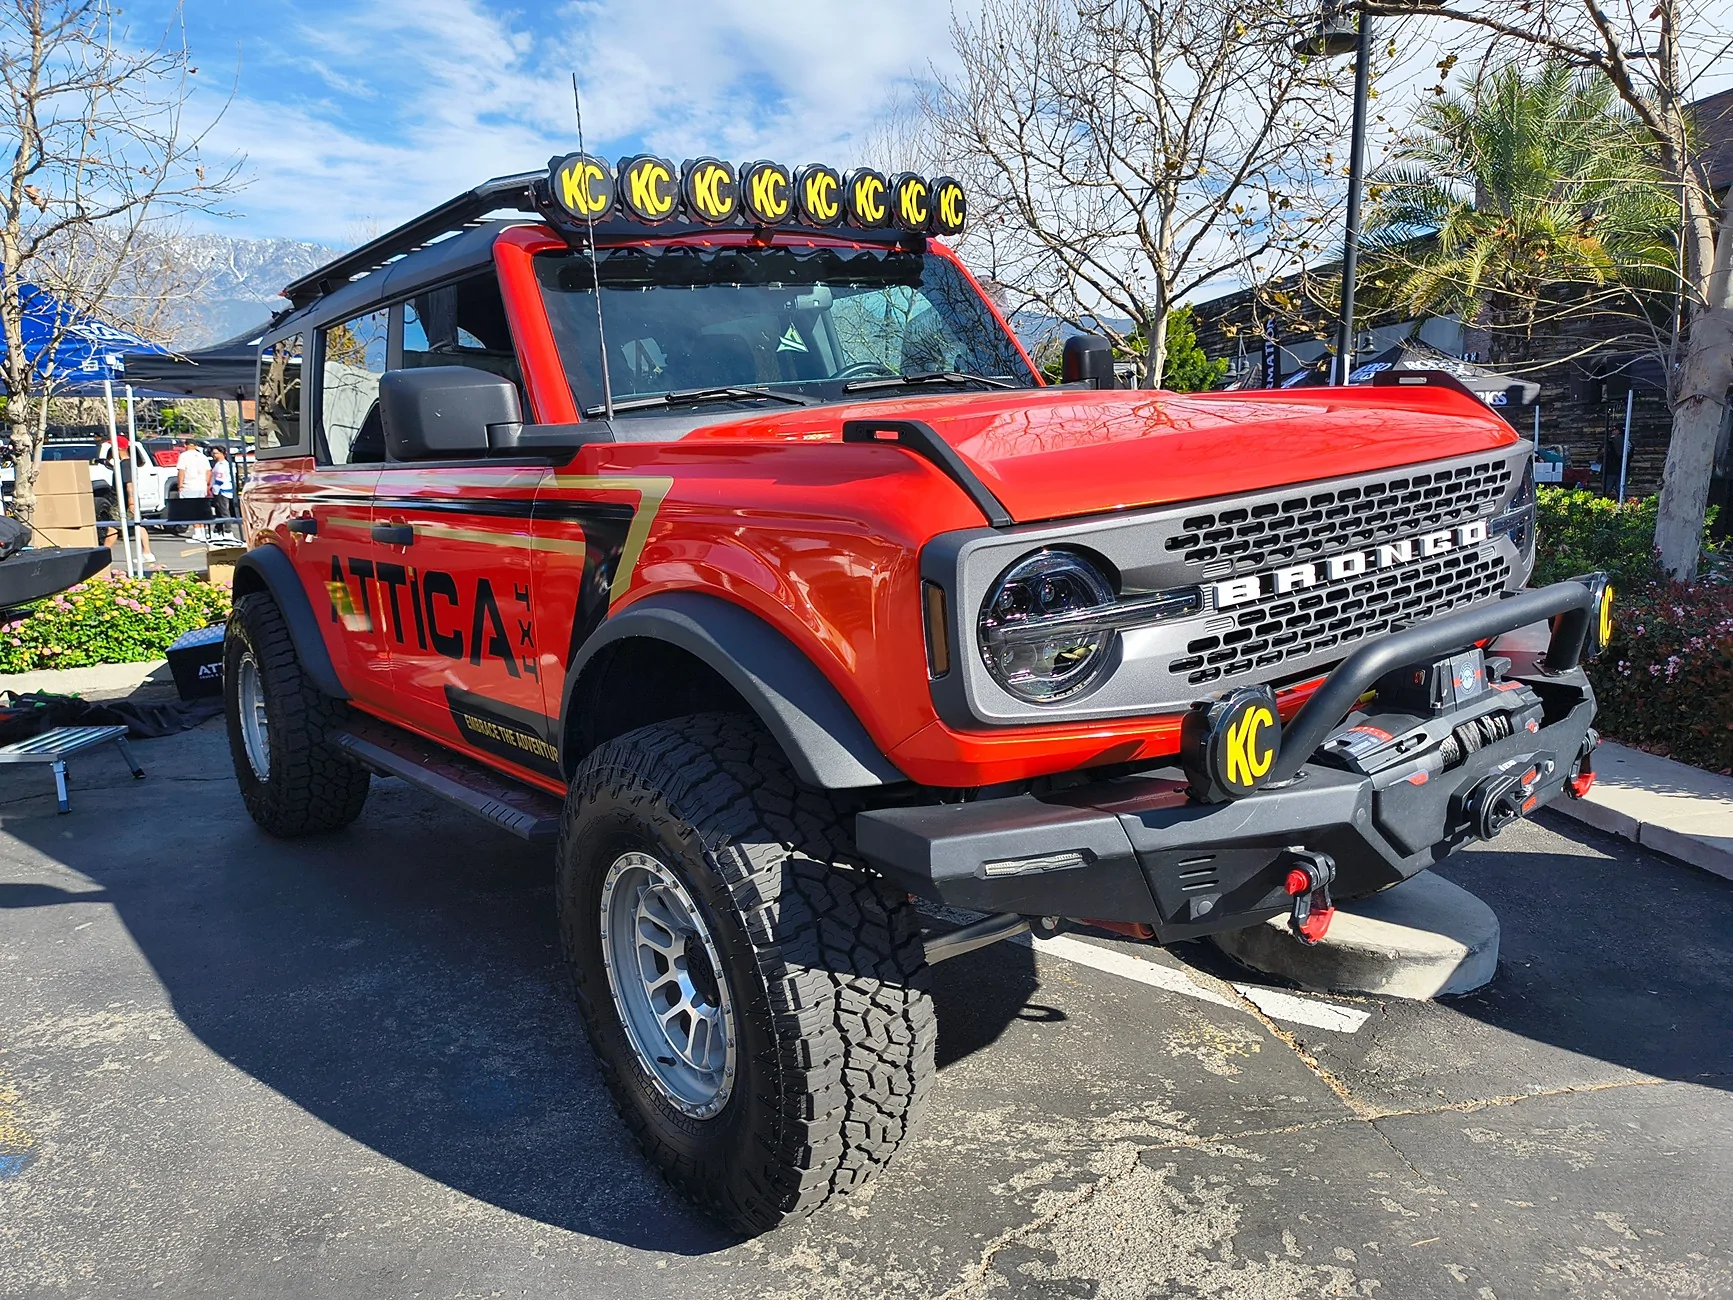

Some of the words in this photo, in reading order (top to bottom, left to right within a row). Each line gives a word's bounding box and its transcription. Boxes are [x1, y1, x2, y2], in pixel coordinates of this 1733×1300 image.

[561, 162, 607, 214] KC
[630, 163, 672, 214] KC
[695, 166, 731, 216] KC
[752, 167, 788, 217] KC
[806, 172, 838, 219] KC
[855, 176, 885, 222] KC
[900, 179, 927, 225] KC
[940, 185, 963, 227] KC
[1217, 519, 1488, 608] BRONCO
[331, 554, 522, 679] ATTICA
[463, 713, 501, 741] EMBRACE
[497, 726, 518, 747] THE
[1226, 705, 1274, 787] KC
